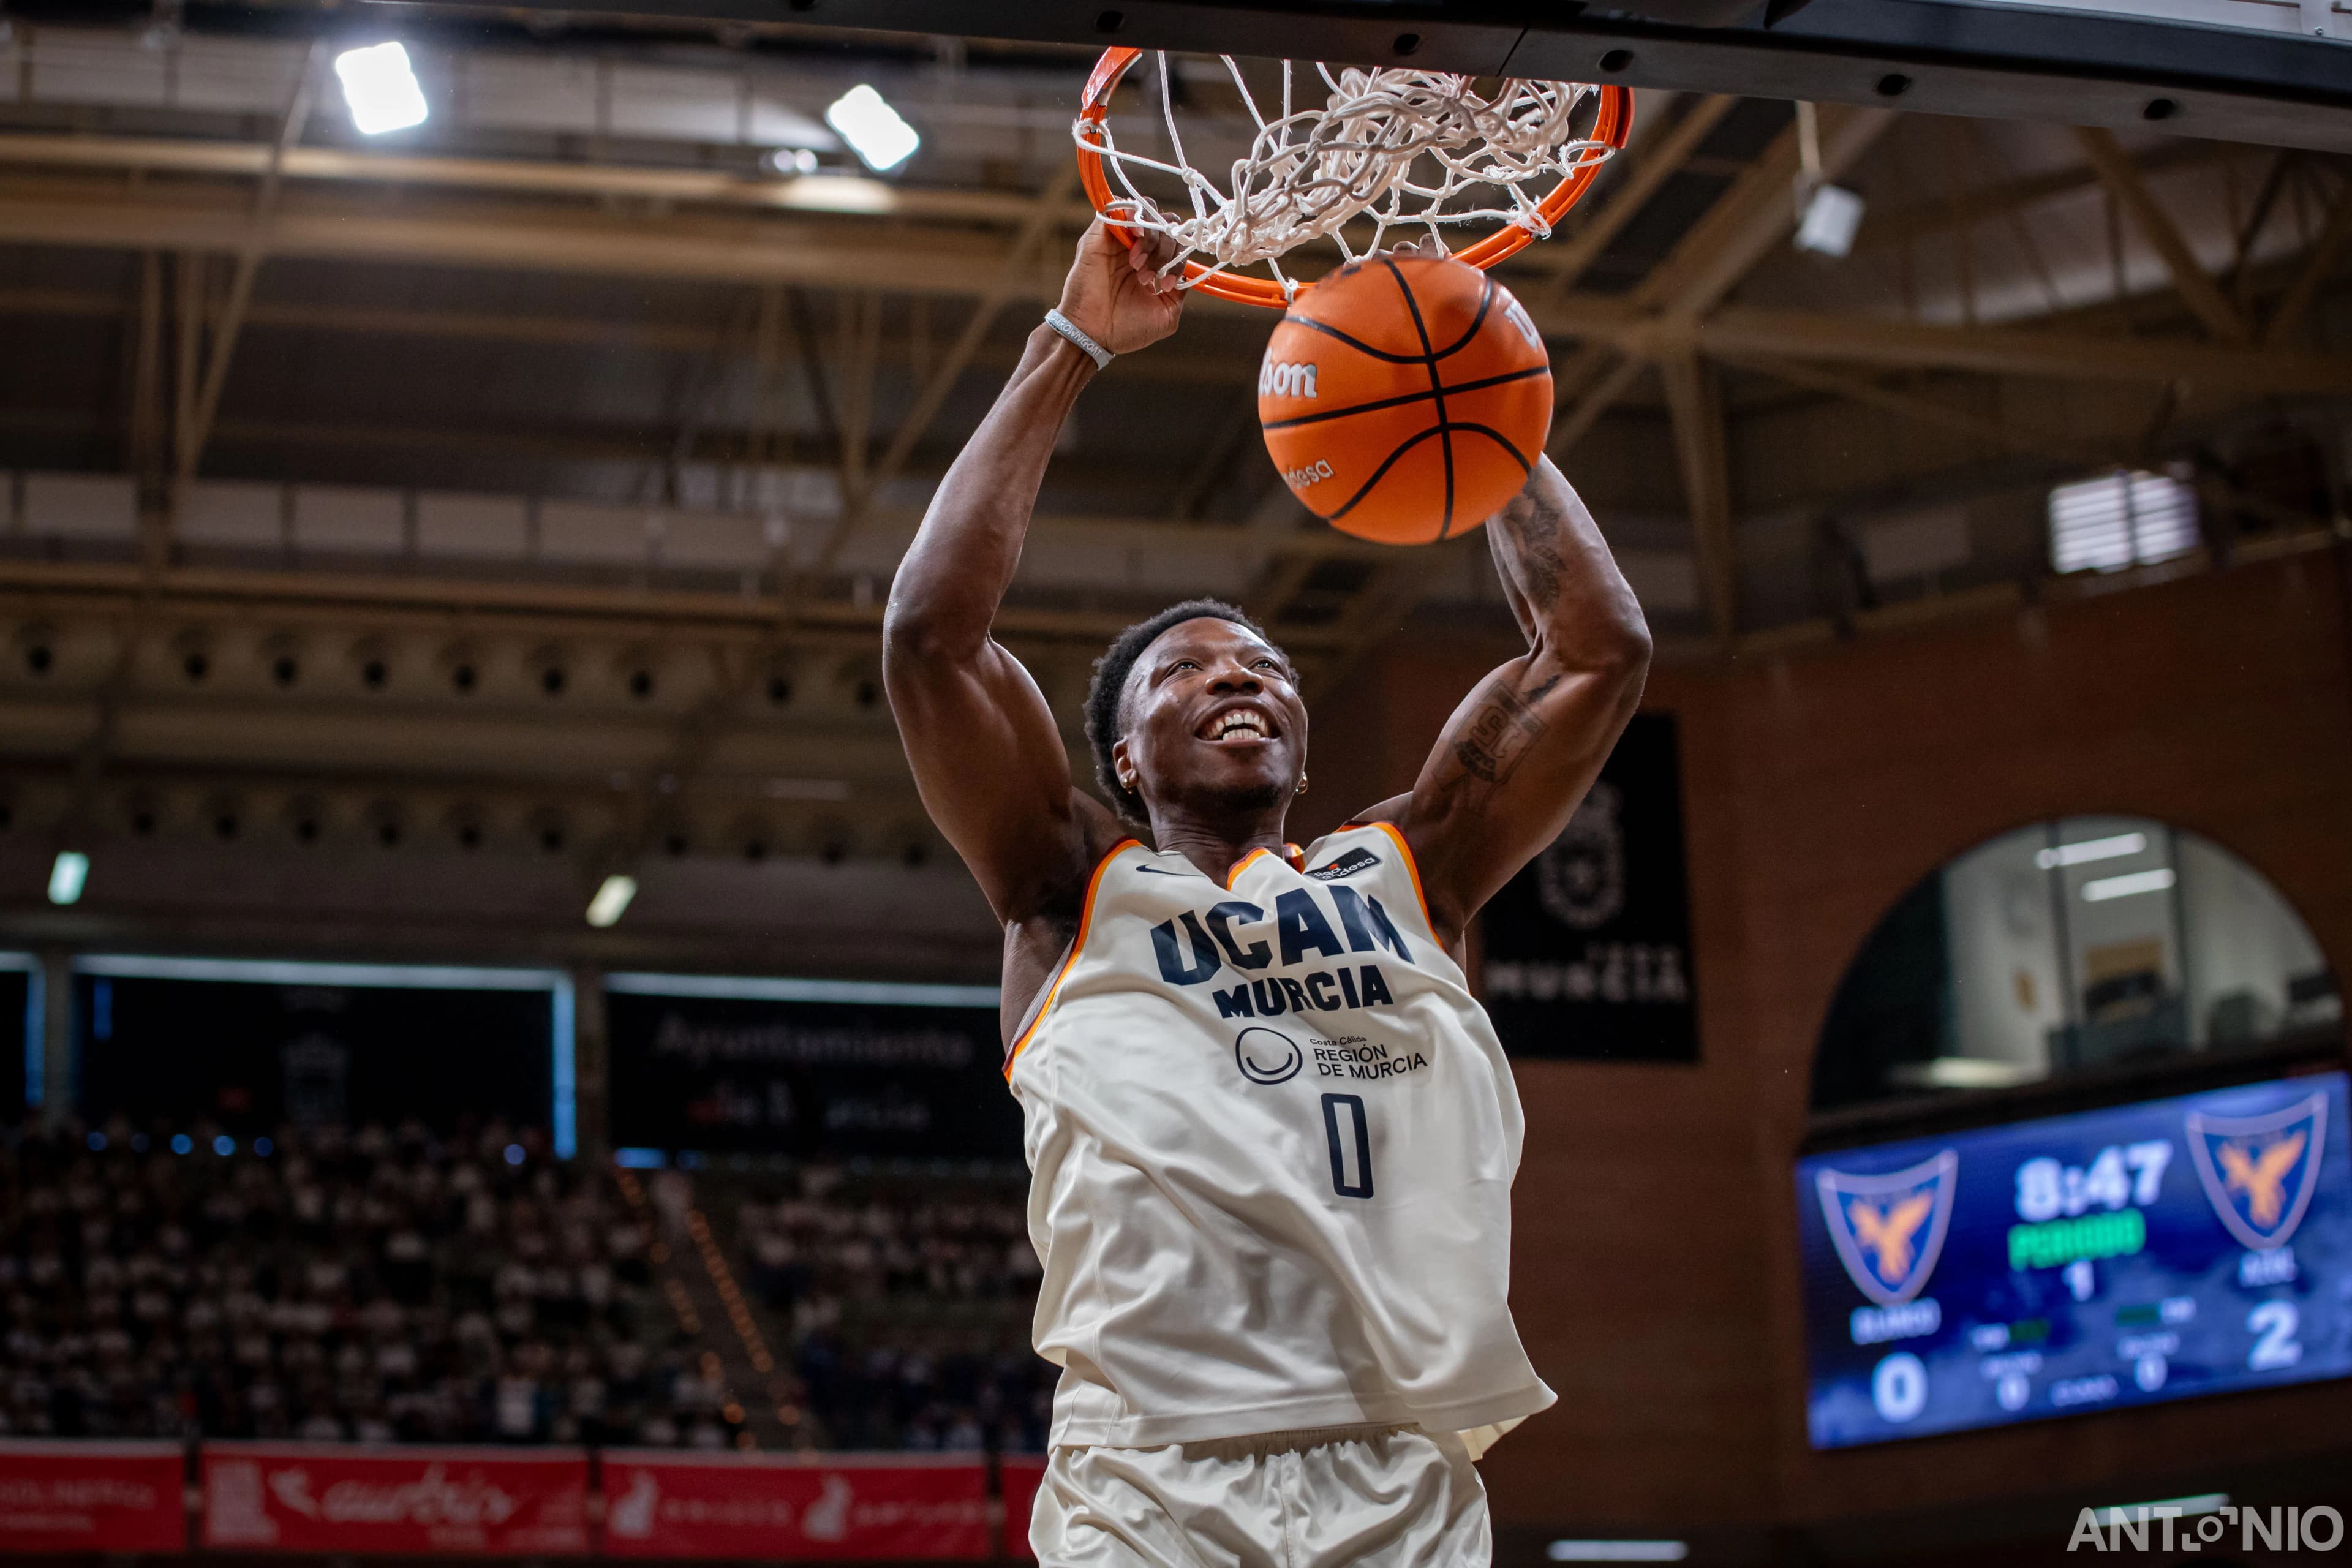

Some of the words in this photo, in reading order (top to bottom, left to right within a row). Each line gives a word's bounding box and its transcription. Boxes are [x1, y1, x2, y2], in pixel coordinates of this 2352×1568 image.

[1150, 885, 1415, 986] UCAM
[1212, 965, 1394, 1019] MURCIA
[1313, 1044, 1388, 1063] REGIÓN
[1317, 1063, 1344, 1076] DE
[1349, 1053, 1428, 1079] MURCIA
[1340, 1036, 1367, 1046] Cálida
[1321, 1093, 1374, 1199] 0
[2015, 1140, 2173, 1221] 8:47
[2062, 1261, 2094, 1301] 1
[2245, 1300, 2303, 1371] 2
[1872, 1352, 1928, 1422] 0
